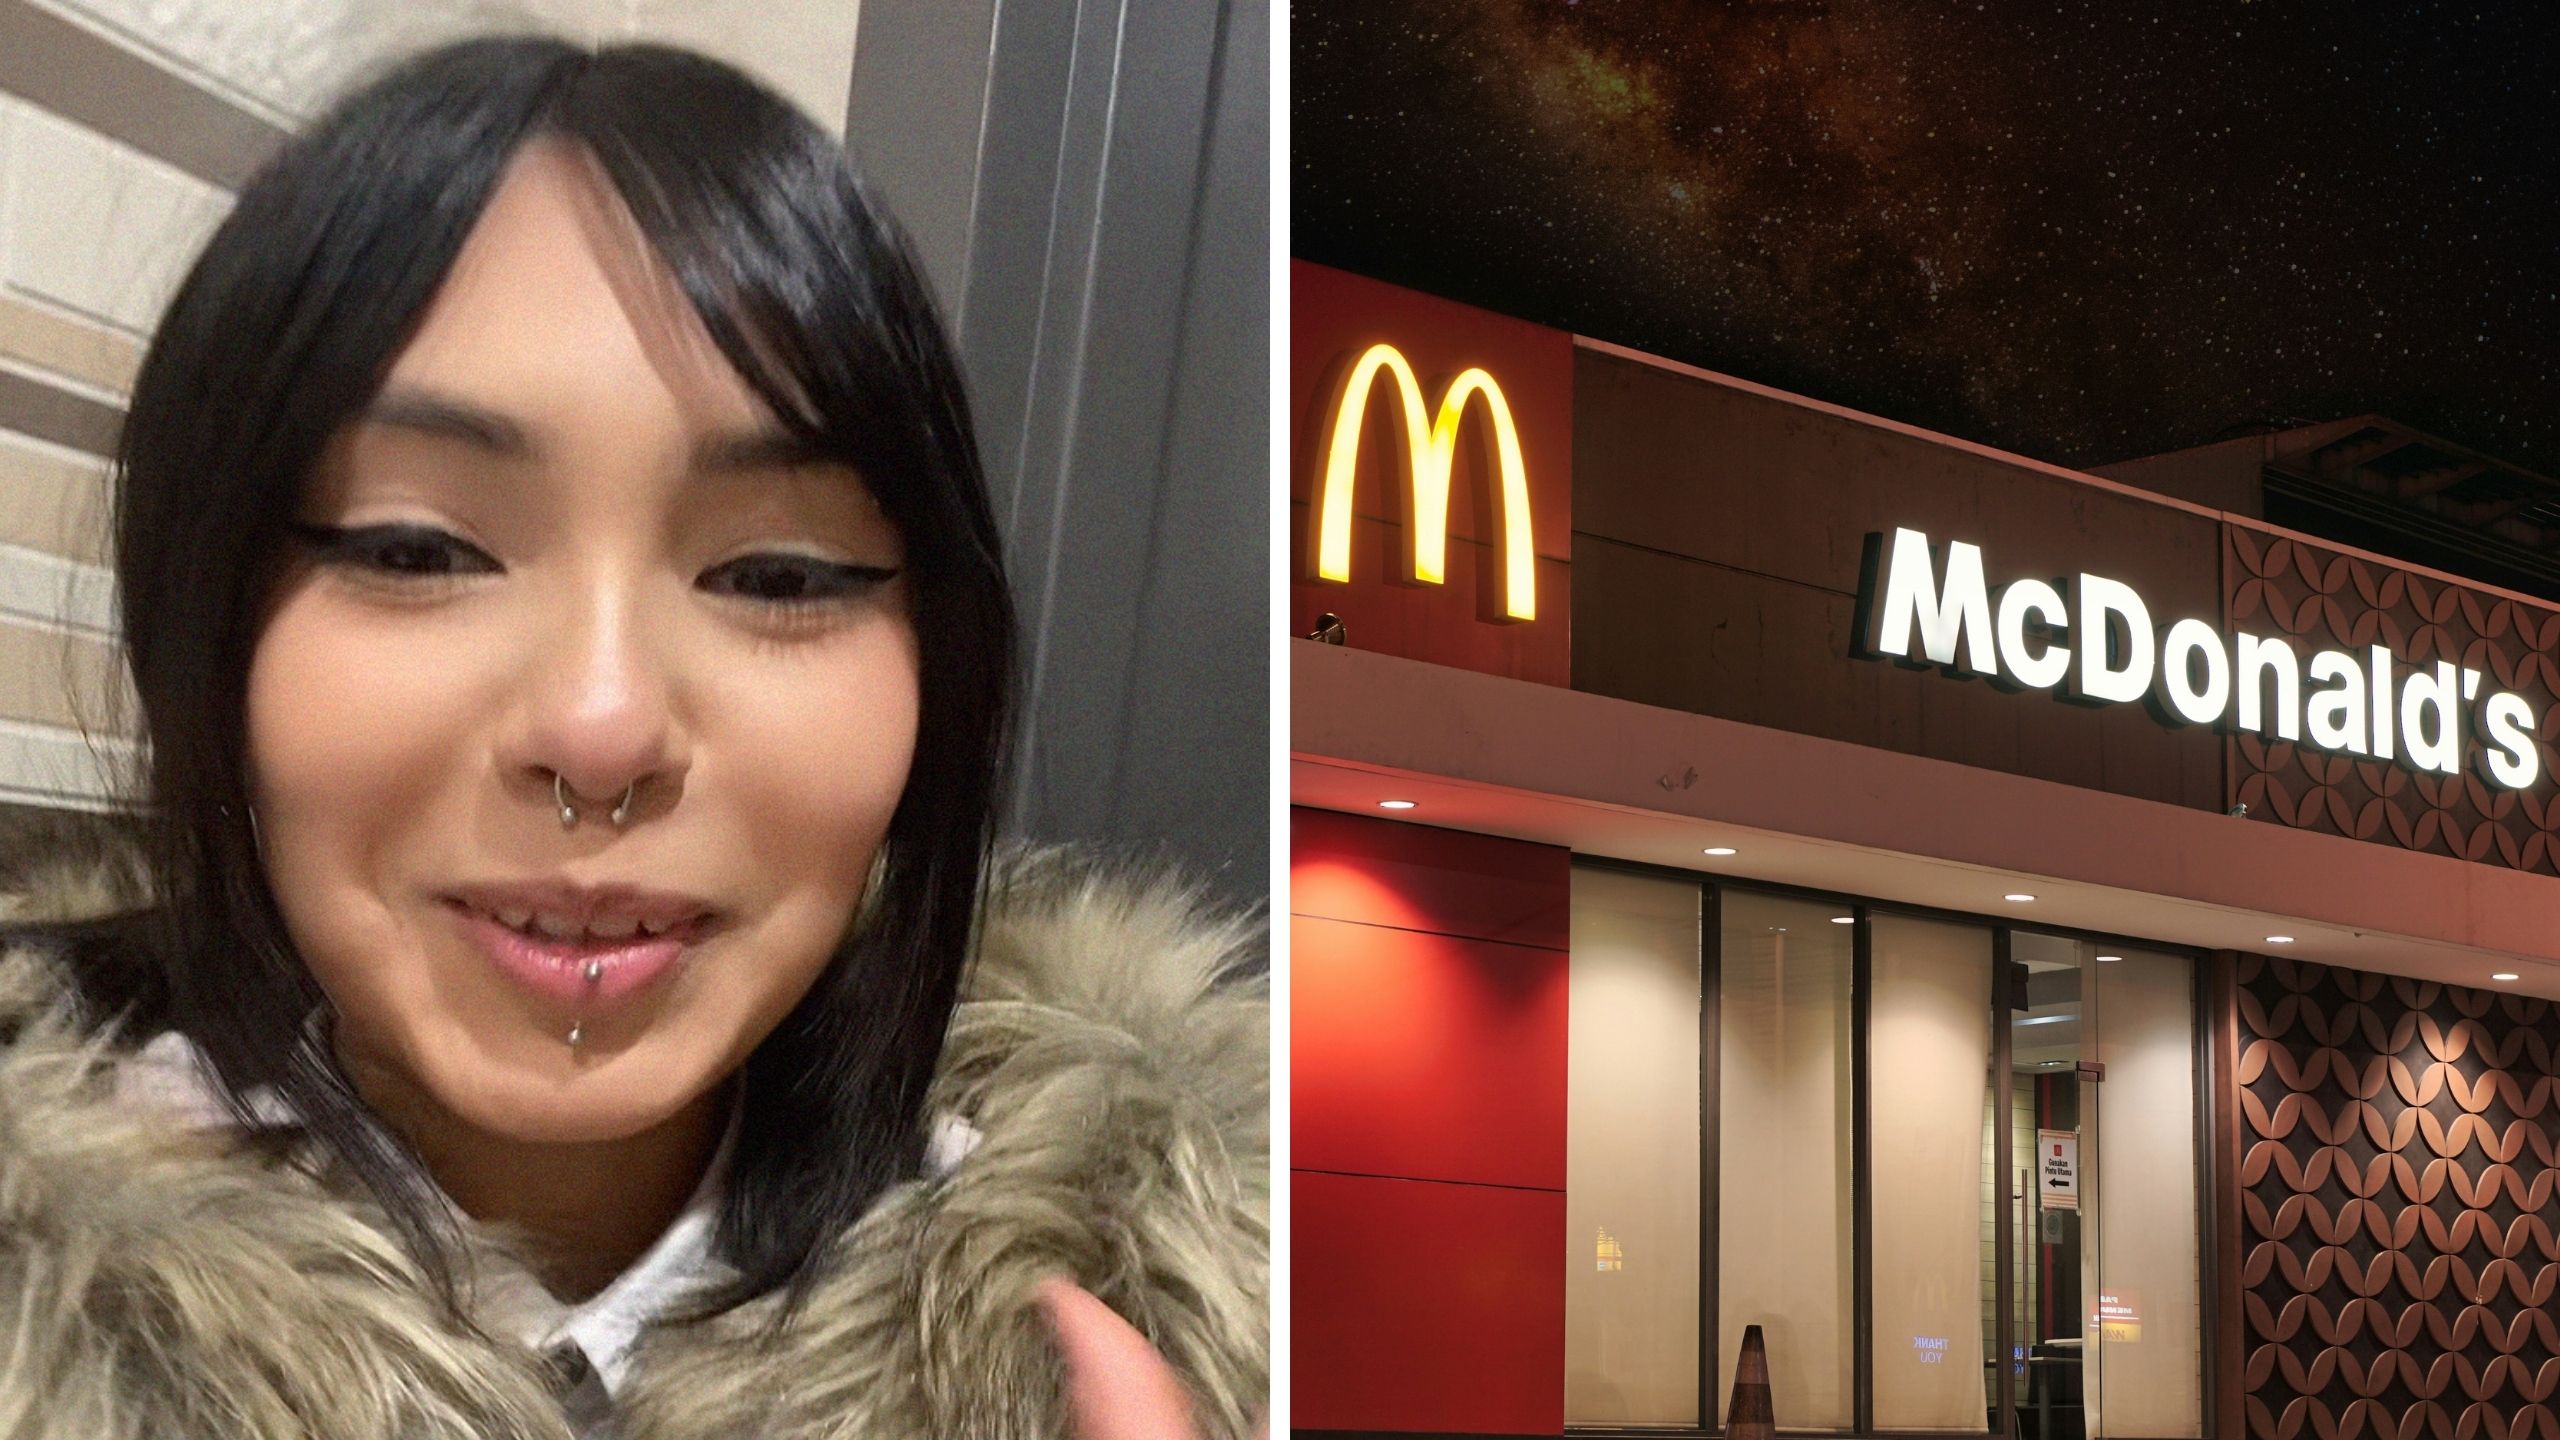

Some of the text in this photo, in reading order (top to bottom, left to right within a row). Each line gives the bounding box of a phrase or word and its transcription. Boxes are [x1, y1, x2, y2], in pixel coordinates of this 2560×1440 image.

[1879, 526, 2539, 789] McDonald's
[2049, 1158, 2068, 1167] Gunakan
[2045, 1167, 2072, 1176] Pintu Utama
